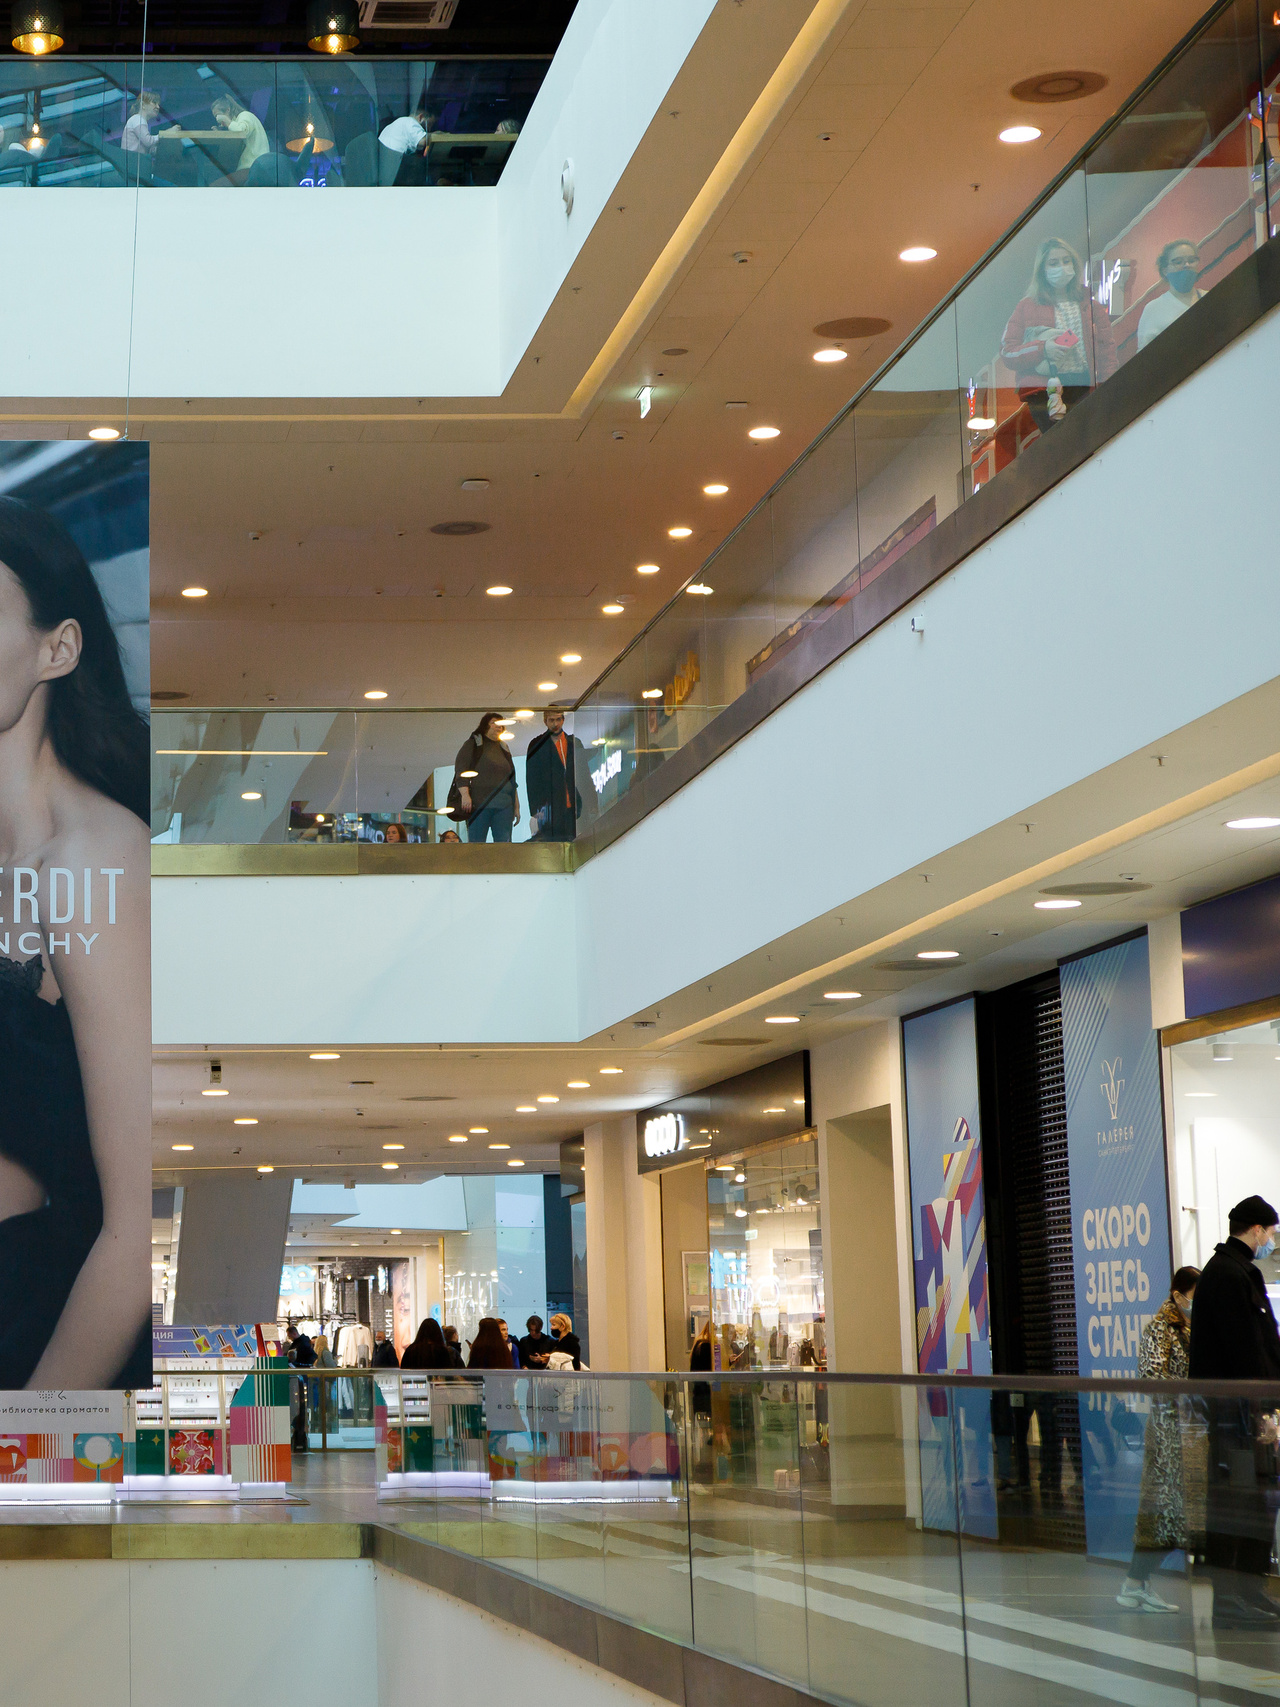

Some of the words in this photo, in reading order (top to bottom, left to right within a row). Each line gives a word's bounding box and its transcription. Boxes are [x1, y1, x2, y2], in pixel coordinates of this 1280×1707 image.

[1097, 1125, 1134, 1145] ГАЛЕРЕЯ
[1082, 1202, 1151, 1251] СКОРО
[1085, 1259, 1150, 1311] ЗДЕСЬ
[1088, 1314, 1157, 1358] СТАН
[59, 1406, 110, 1415] ароматов
